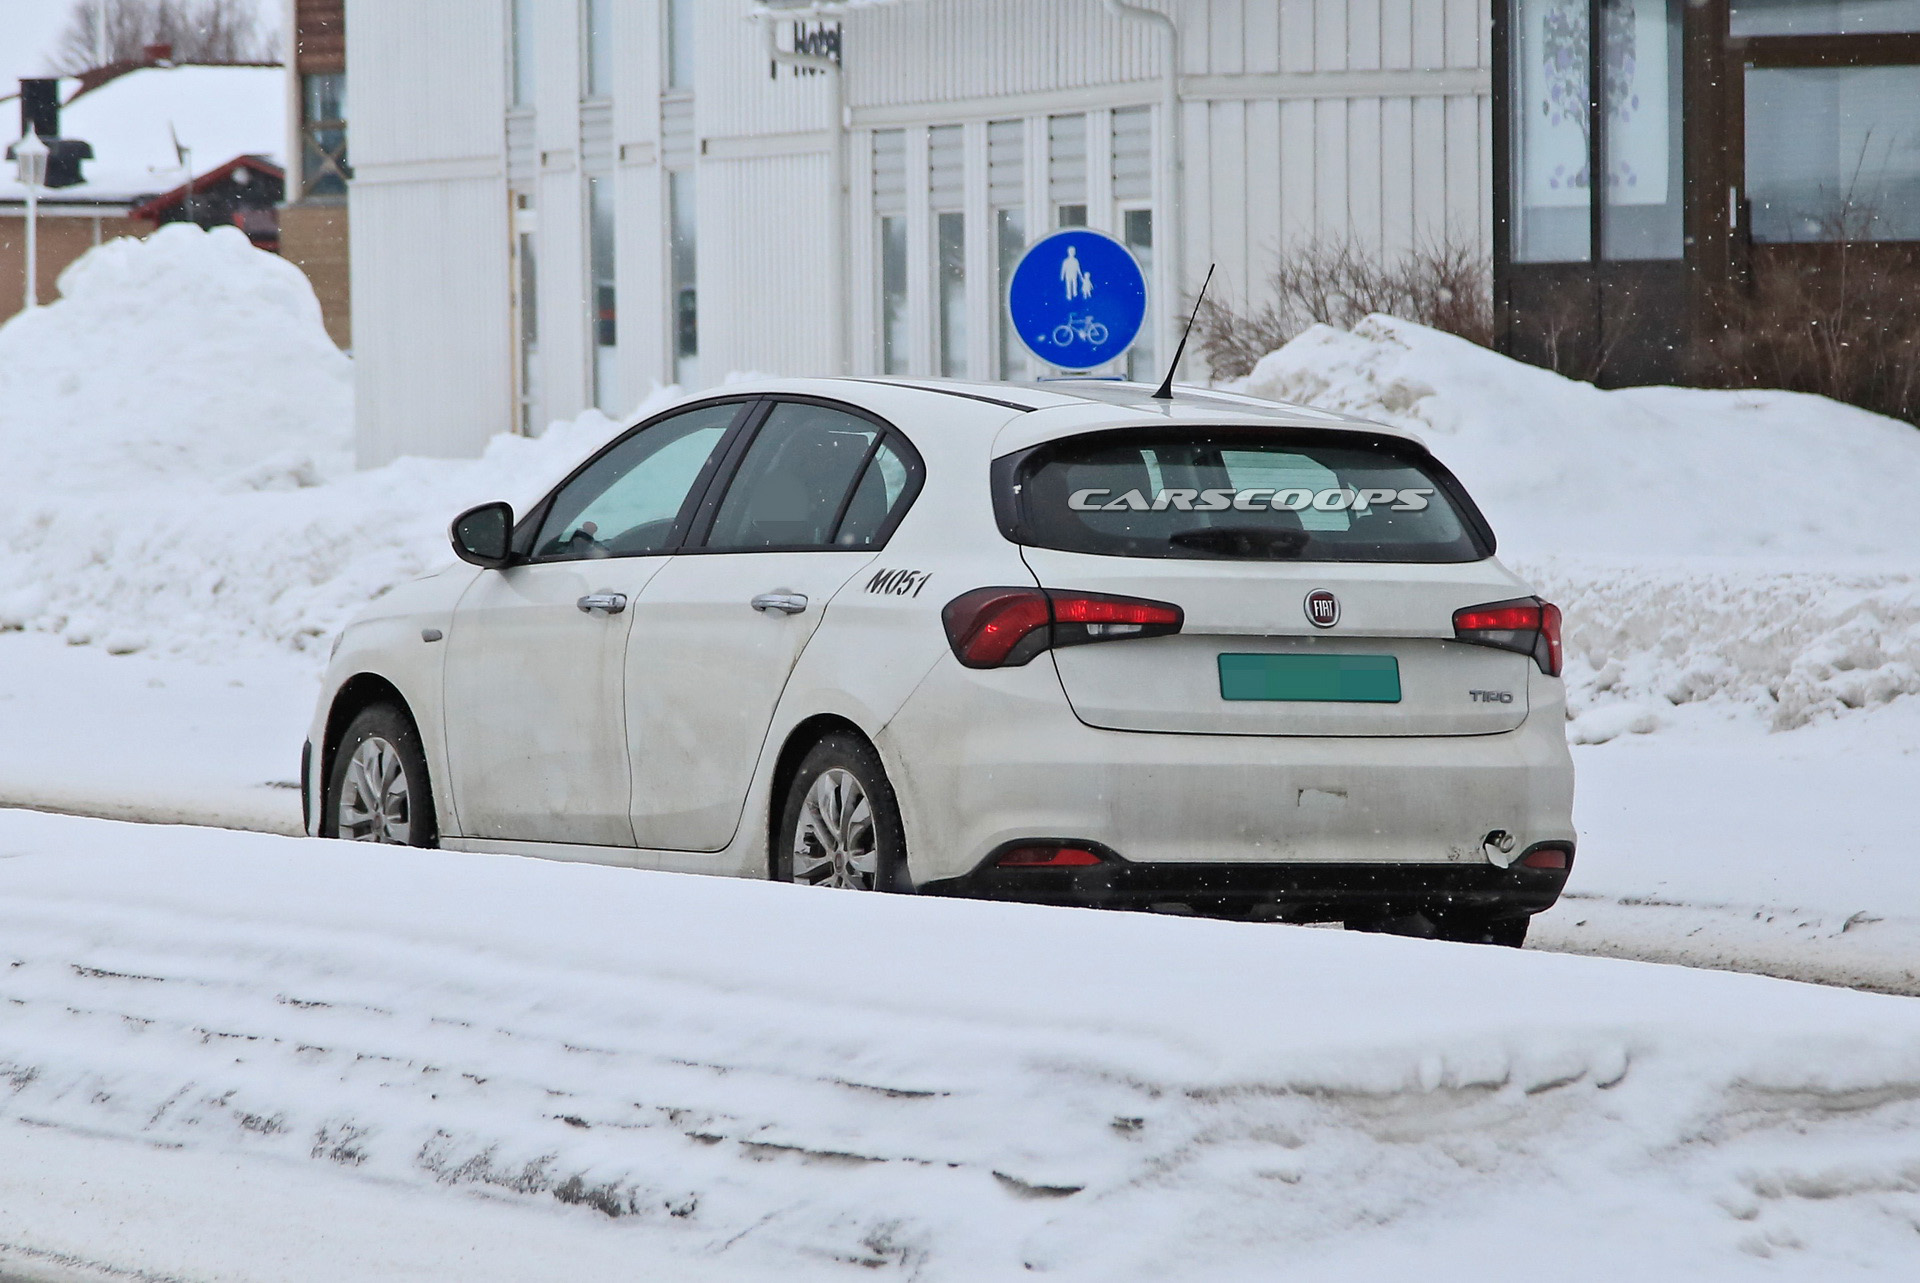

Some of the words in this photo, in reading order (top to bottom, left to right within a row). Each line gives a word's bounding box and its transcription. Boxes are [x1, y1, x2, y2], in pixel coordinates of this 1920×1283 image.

[864, 568, 933, 598] M051
[1313, 600, 1334, 617] FIAT
[1469, 690, 1513, 703] TIPO
